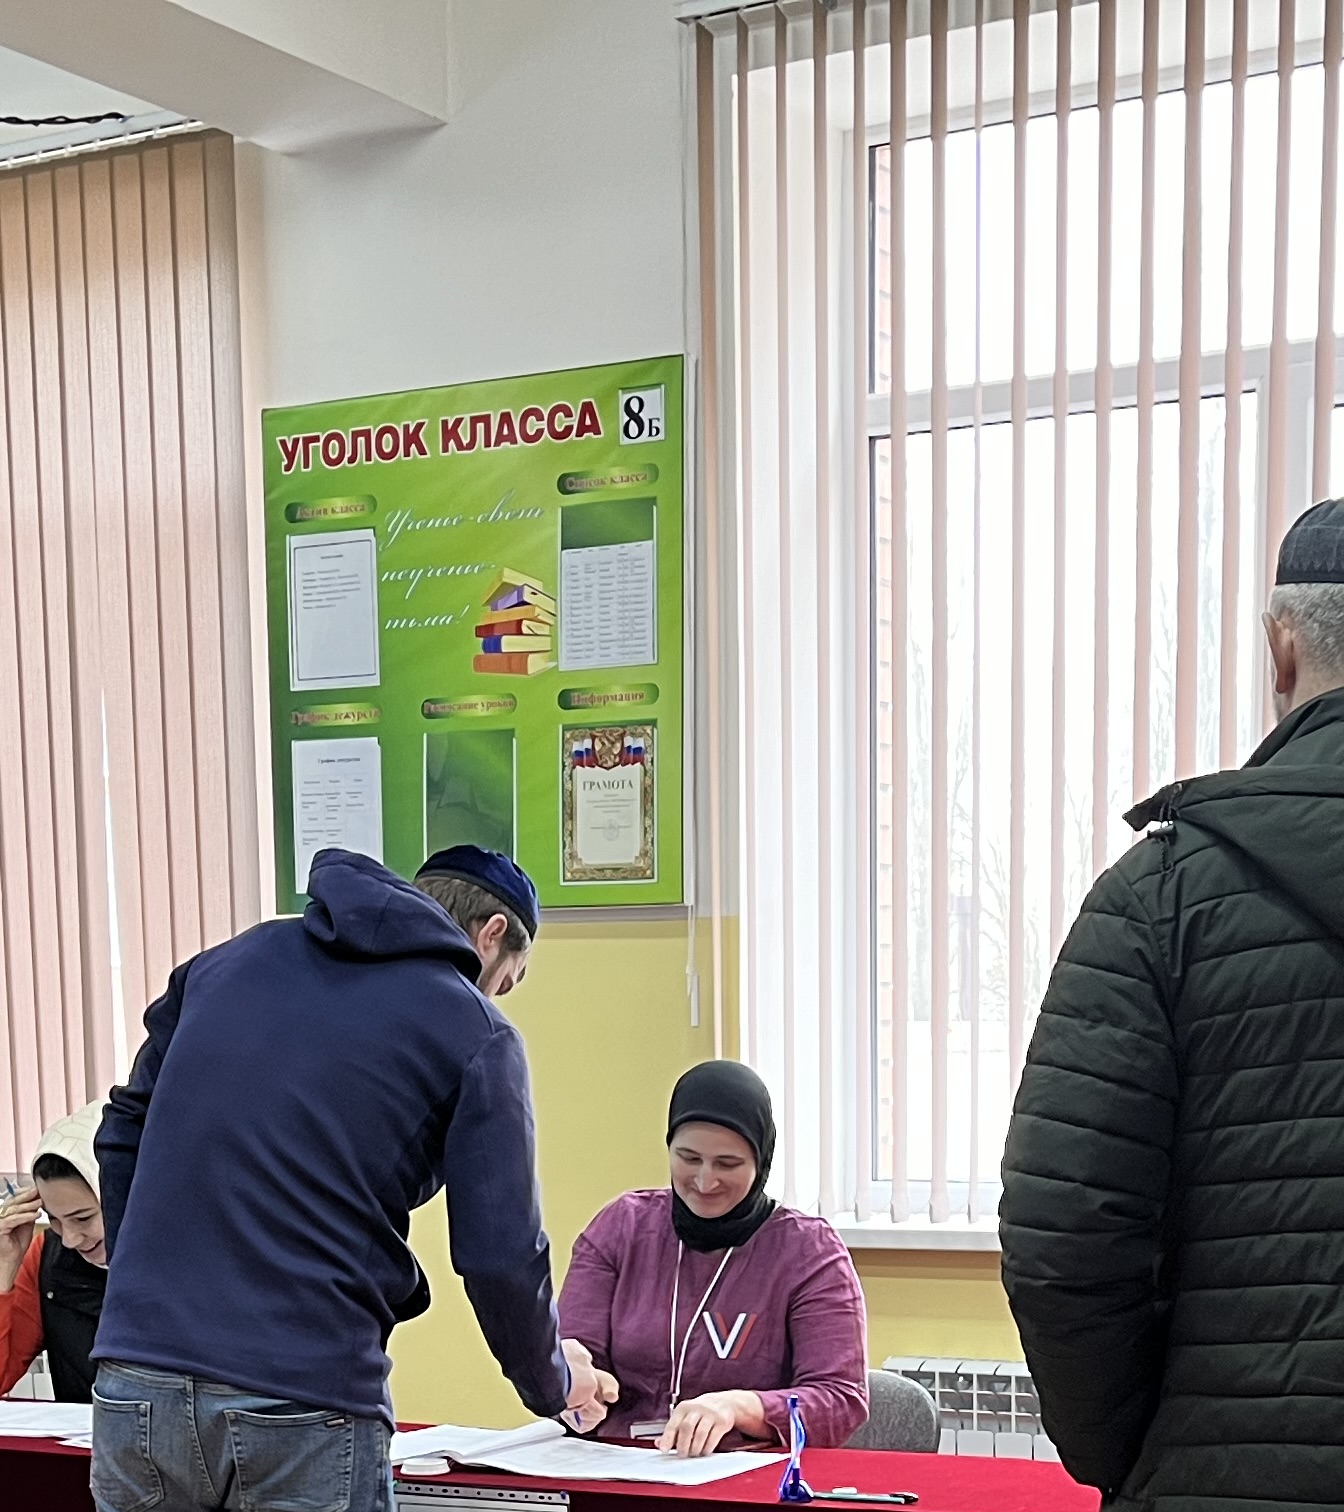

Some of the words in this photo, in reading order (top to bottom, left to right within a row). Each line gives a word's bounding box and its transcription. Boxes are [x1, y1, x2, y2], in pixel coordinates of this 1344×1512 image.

[279, 420, 430, 474] УГОЛОК
[440, 399, 603, 454] КЛАССА
[582, 779, 634, 791] ГРАМОТА
